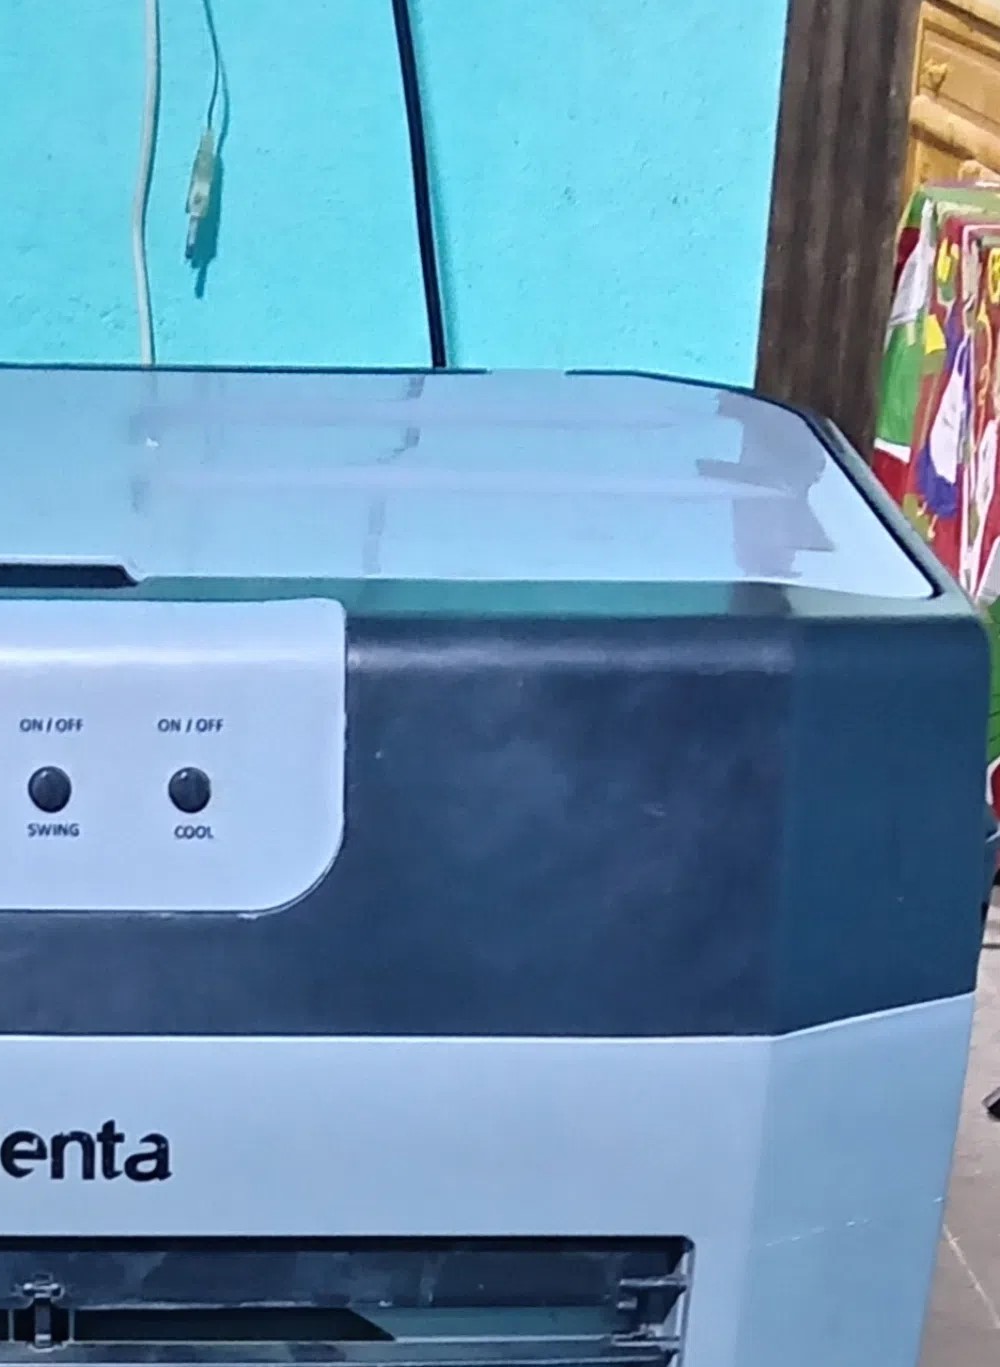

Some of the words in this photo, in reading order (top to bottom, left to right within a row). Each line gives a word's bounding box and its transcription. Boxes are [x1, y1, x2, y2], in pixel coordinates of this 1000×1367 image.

[19, 718, 44, 733] ON
[55, 718, 84, 733] OFF
[157, 718, 181, 733] ON
[195, 718, 224, 733] OFF
[27, 822, 80, 838] SWING
[174, 825, 214, 840] COOL
